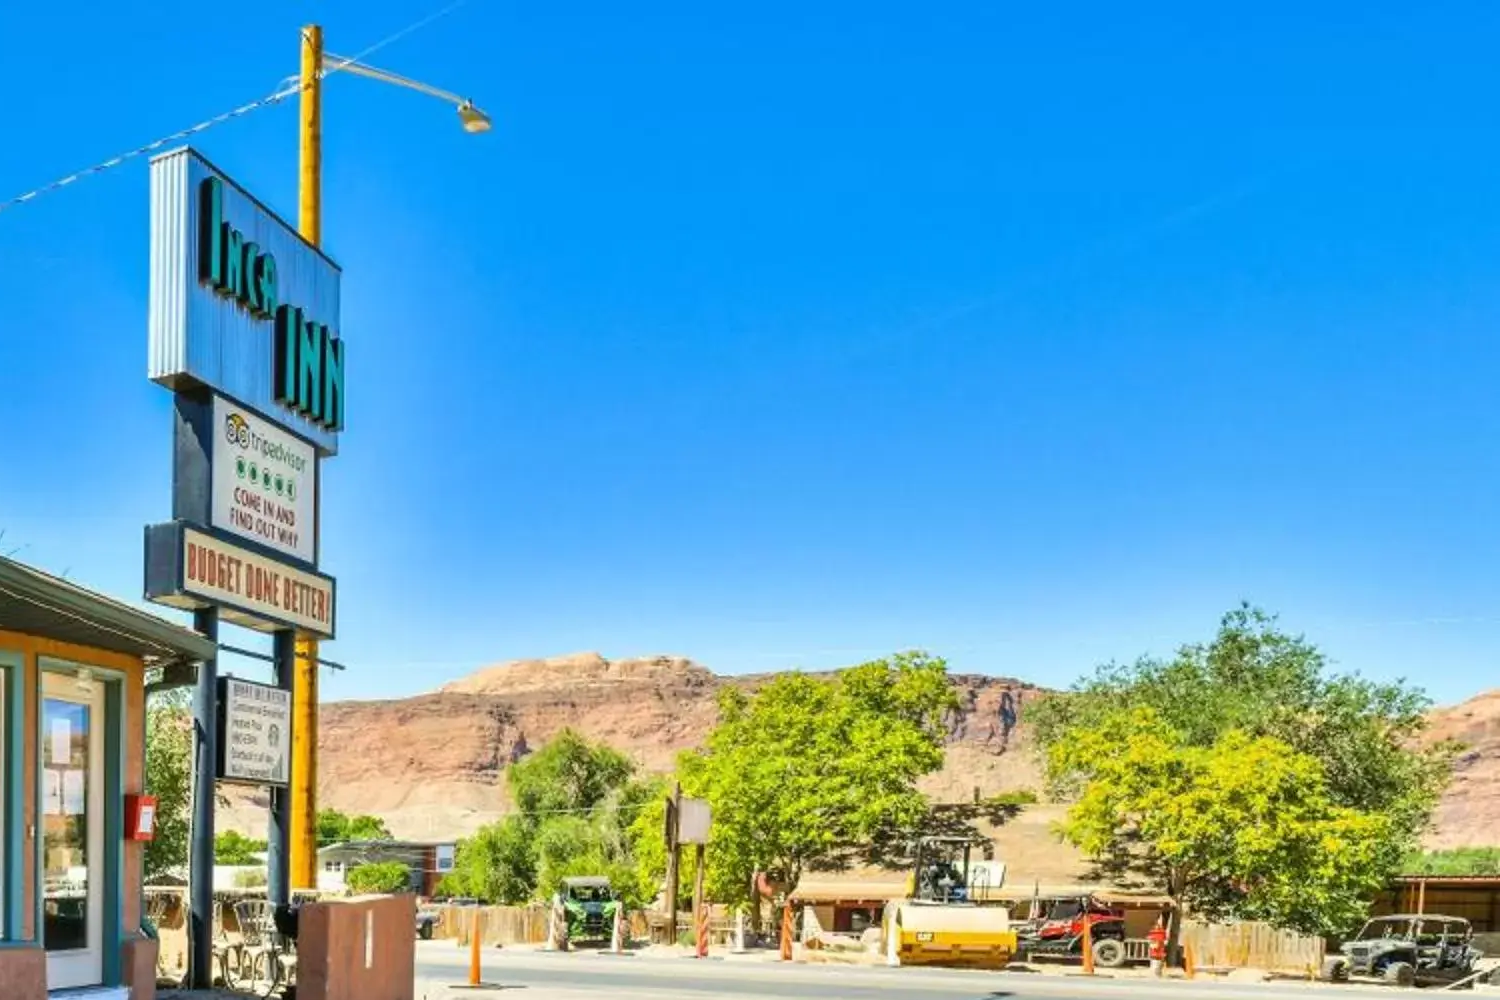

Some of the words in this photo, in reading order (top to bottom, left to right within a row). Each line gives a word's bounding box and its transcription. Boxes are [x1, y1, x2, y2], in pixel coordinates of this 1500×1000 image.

[275, 304, 344, 431] INN
[251, 432, 308, 473] tripadvisor
[234, 487, 261, 512] COME
[263, 501, 276, 517] IN
[277, 505, 295, 527] AND
[230, 508, 253, 531] FIND
[256, 518, 275, 540] OUT
[278, 526, 298, 549] WHY
[187, 542, 242, 595] BUDGET
[247, 563, 279, 607] DONE
[283, 577, 330, 624] BETTER!
